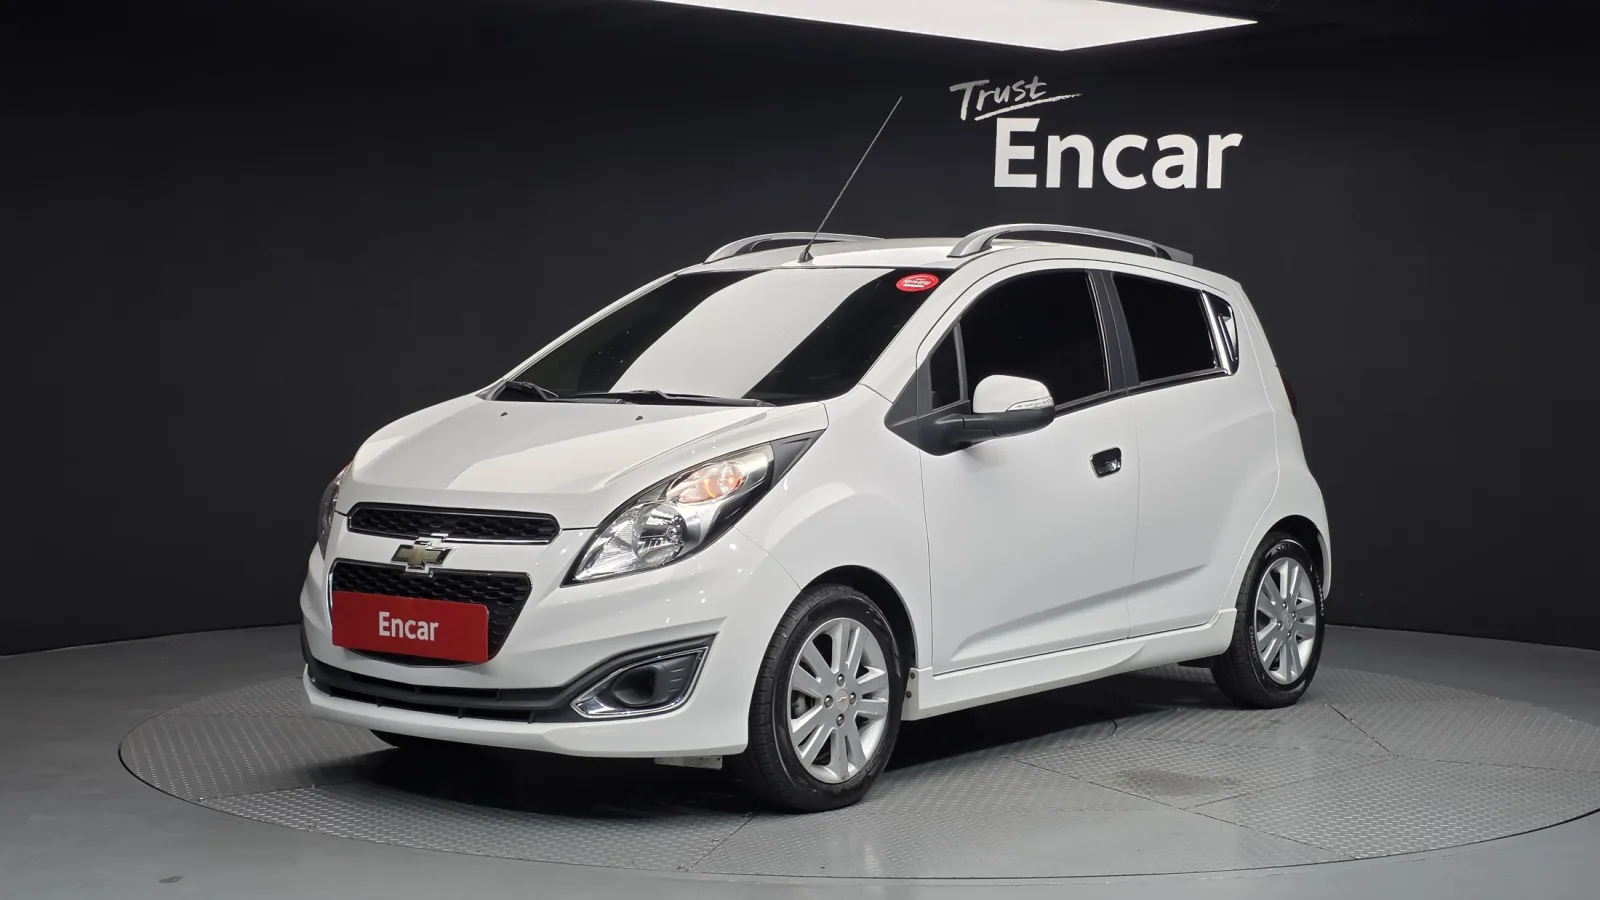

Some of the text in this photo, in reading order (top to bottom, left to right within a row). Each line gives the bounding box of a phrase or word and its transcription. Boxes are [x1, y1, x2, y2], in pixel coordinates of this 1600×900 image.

[949, 75, 1047, 121] Trust
[994, 117, 1243, 189] Encar
[378, 611, 439, 641] Encar
